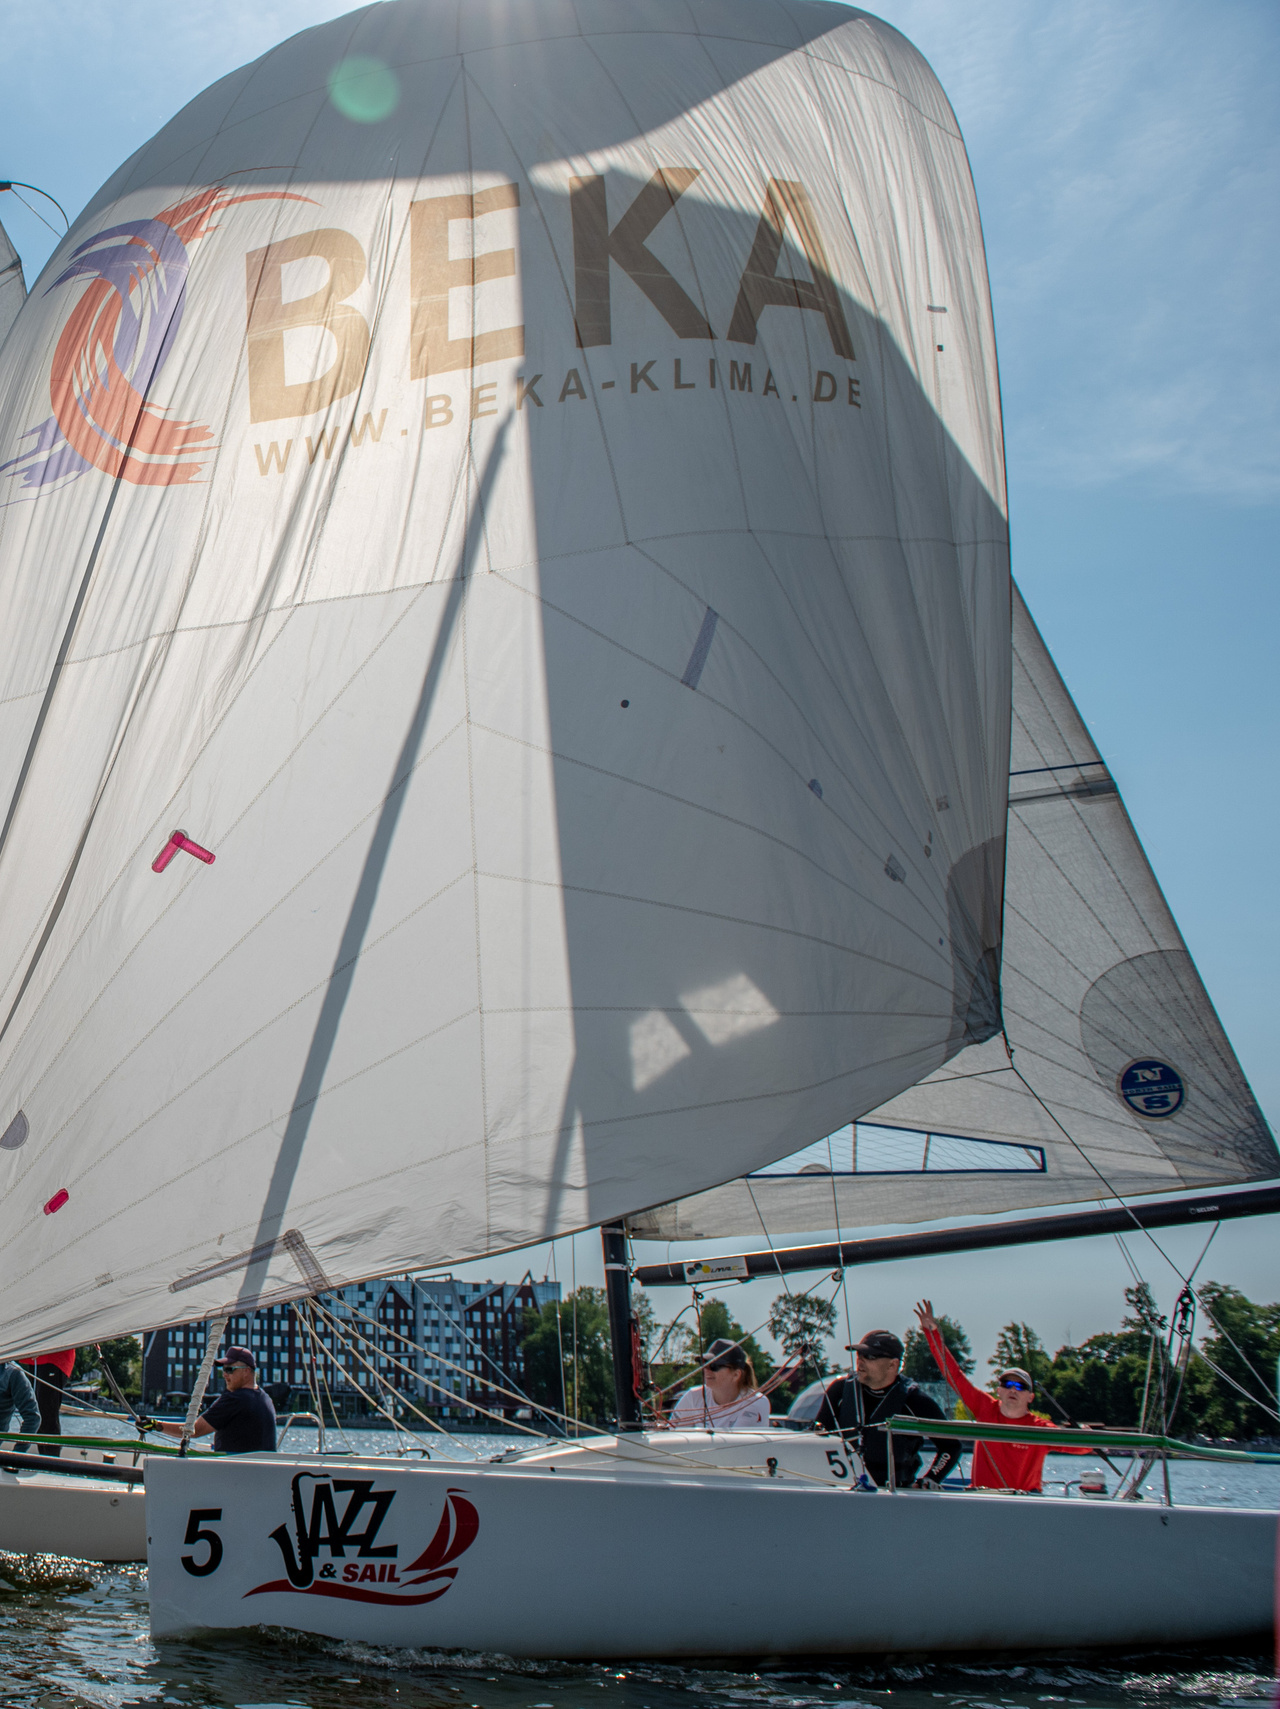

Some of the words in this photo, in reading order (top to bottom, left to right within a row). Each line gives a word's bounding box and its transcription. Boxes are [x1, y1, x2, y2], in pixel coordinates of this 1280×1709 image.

[245, 166, 857, 425] BEKA
[253, 357, 862, 477] WWW.BEKA-KLIMA.DE
[1122, 1087, 1153, 1095] NORTH
[1157, 1084, 1182, 1092] SAILS
[825, 1449, 848, 1479] 5
[180, 1508, 223, 1578] 5
[268, 1471, 398, 1590] JAZZ
[319, 1563, 337, 1579] &
[342, 1563, 401, 1583] SAIL
